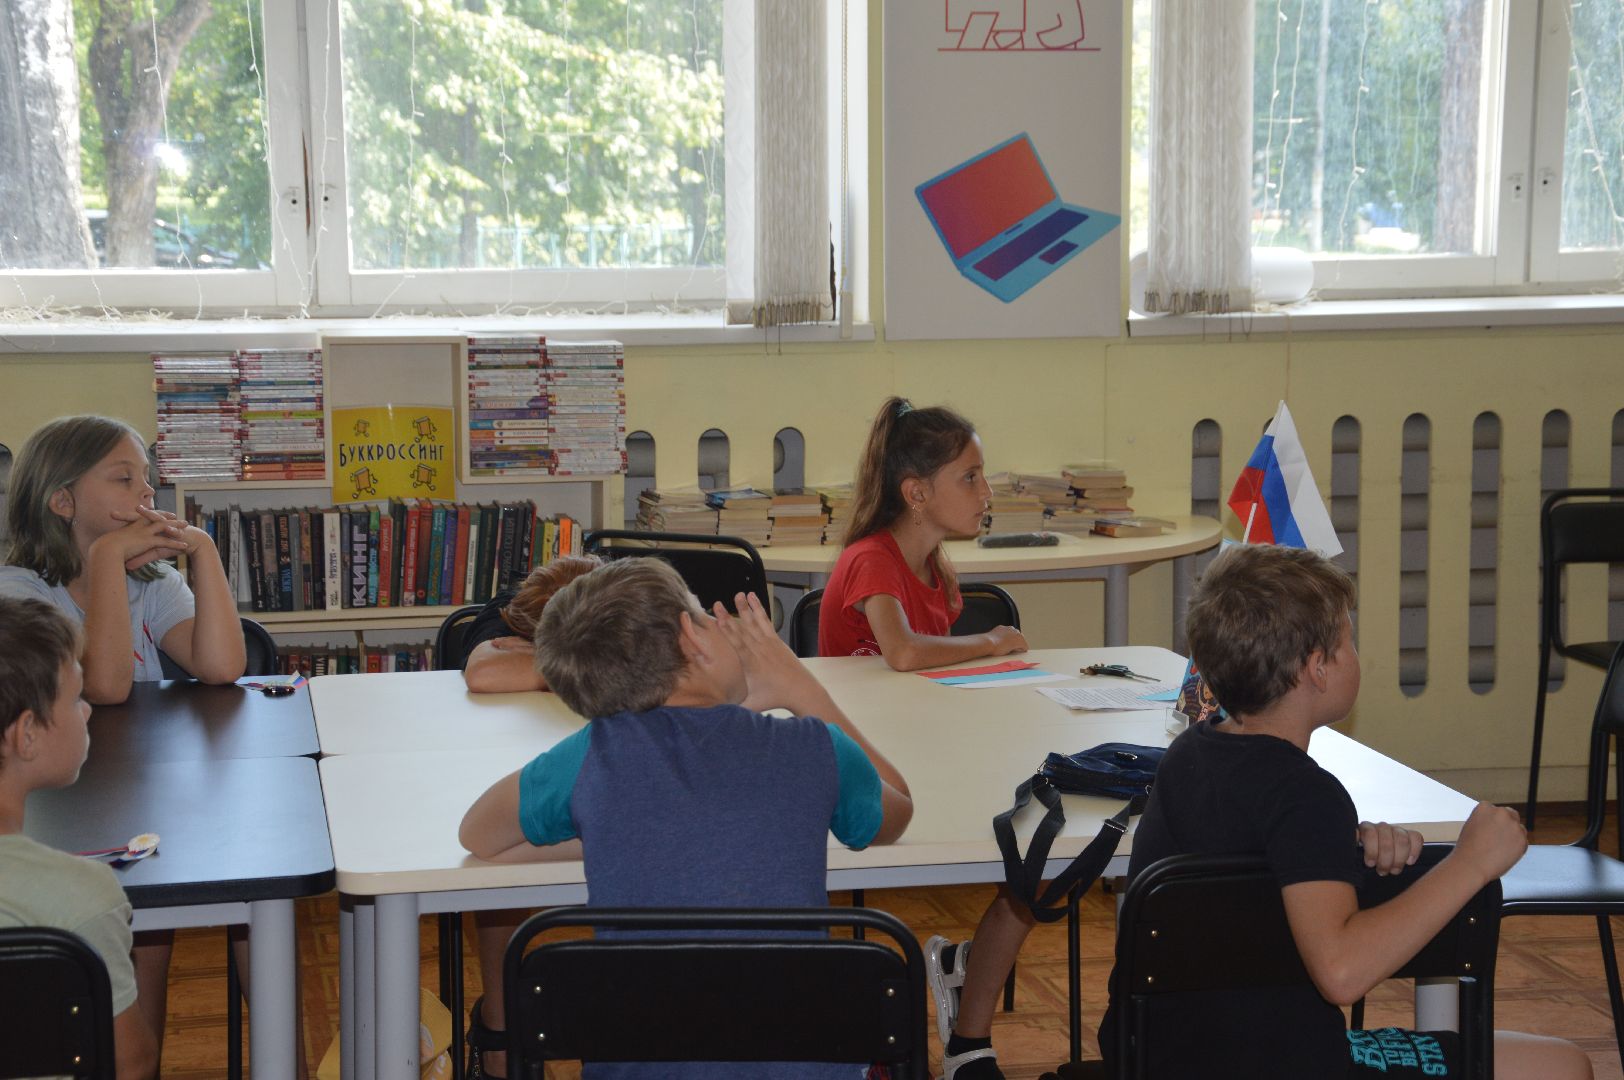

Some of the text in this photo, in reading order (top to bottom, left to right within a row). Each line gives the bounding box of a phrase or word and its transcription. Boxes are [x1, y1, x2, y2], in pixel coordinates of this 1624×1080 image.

[338, 442, 445, 467] БУККРОССИНГ
[352, 525, 367, 606] КИНГ
[1409, 1034, 1448, 1076] STAY
